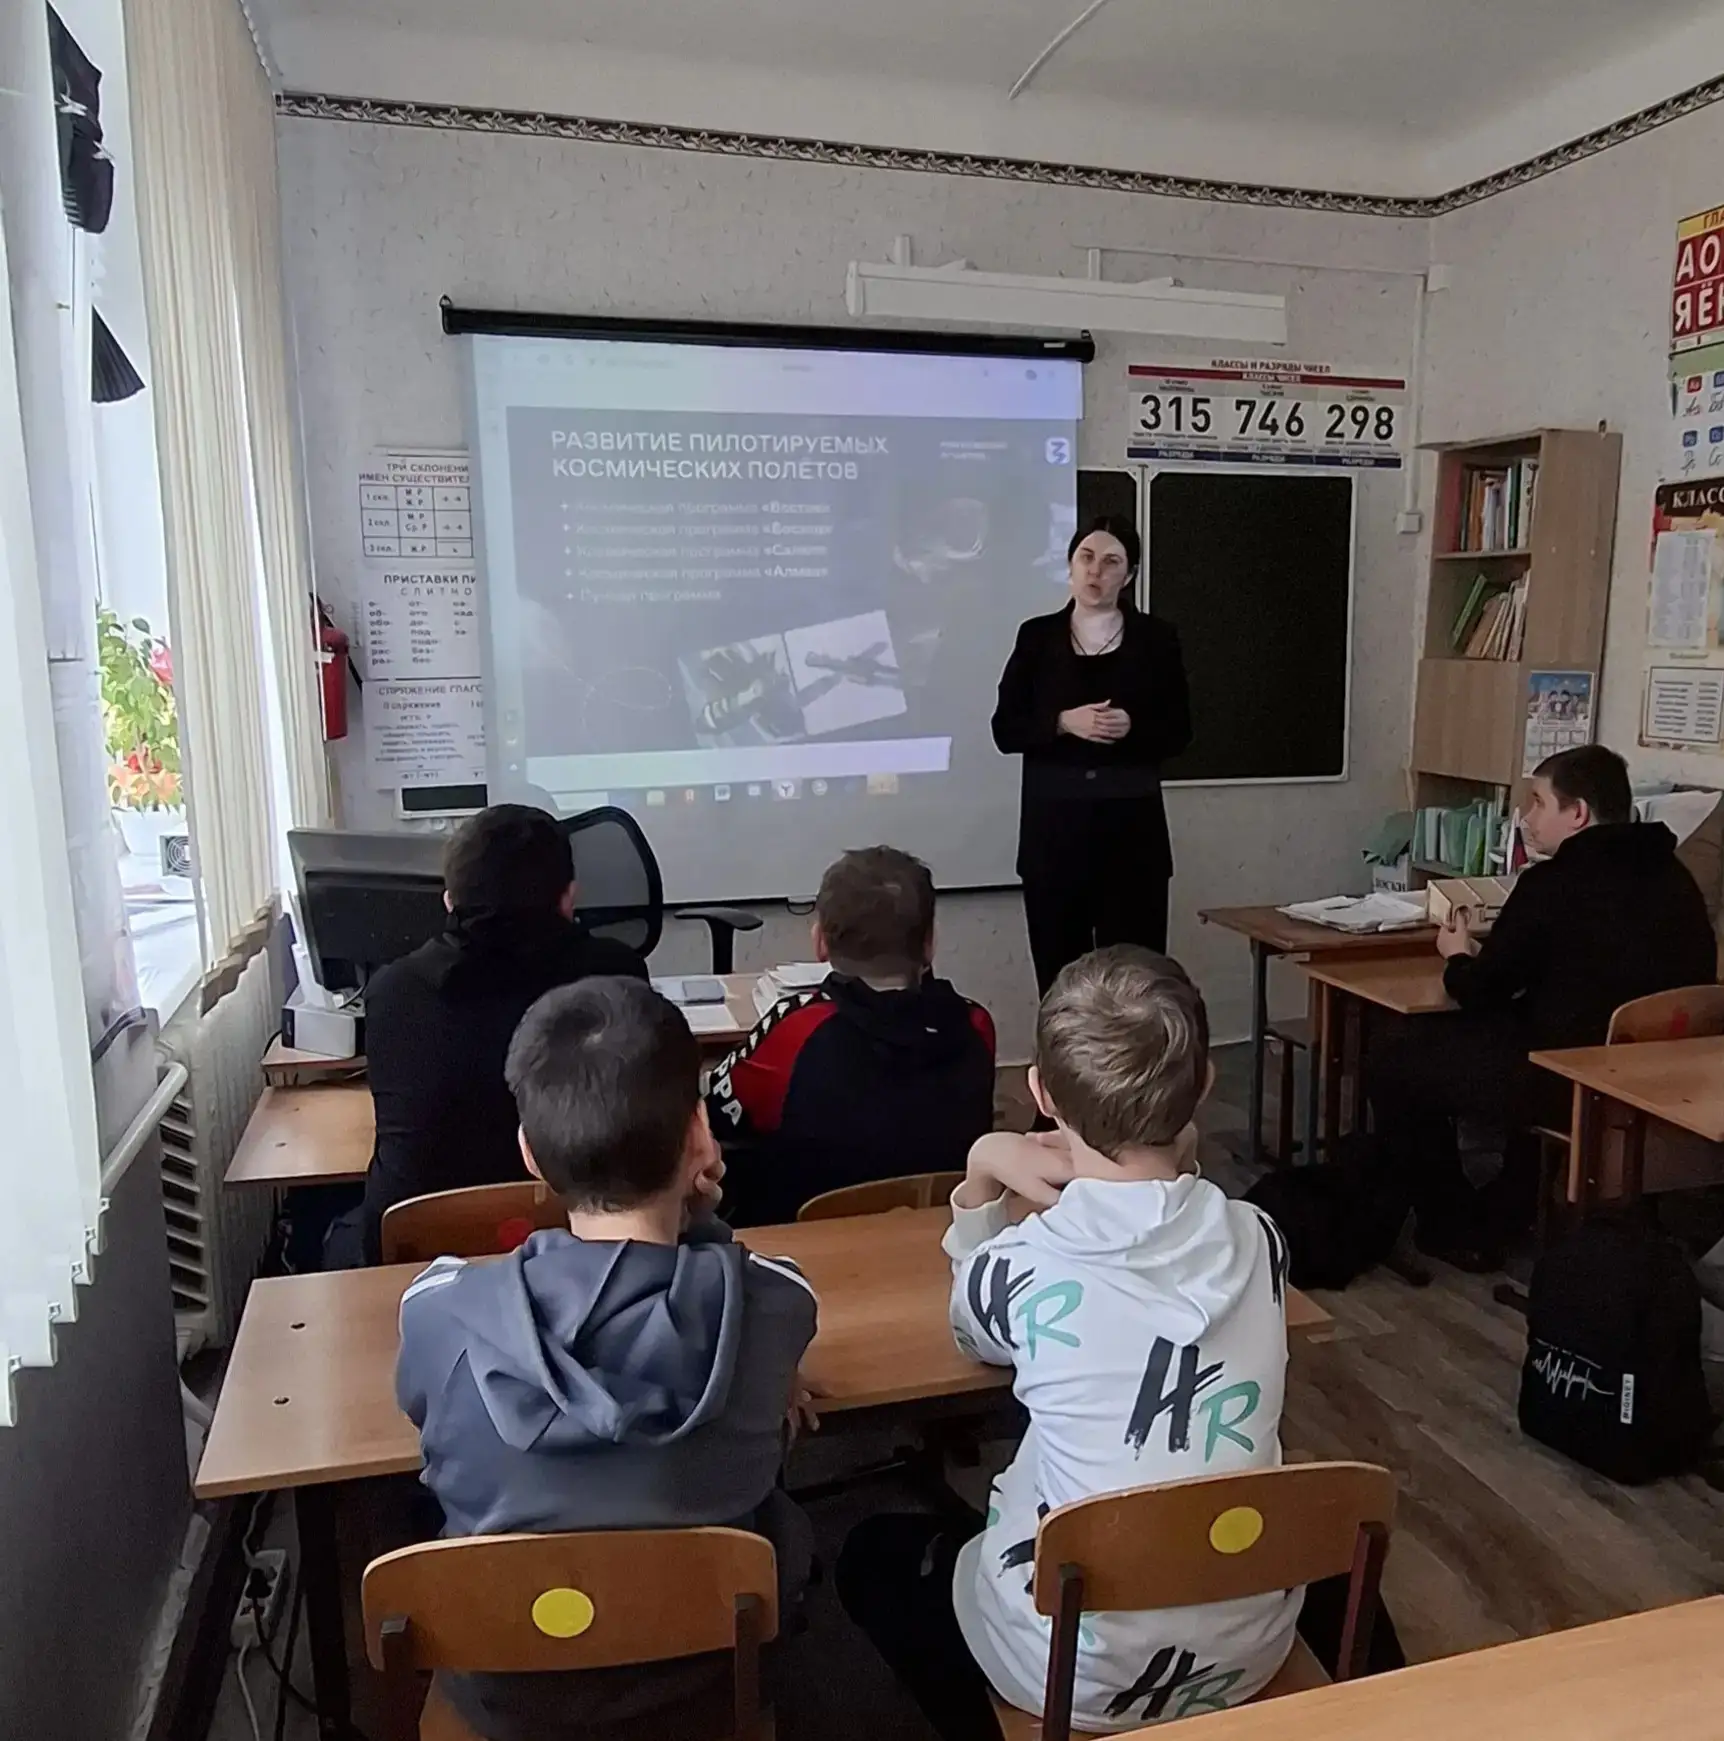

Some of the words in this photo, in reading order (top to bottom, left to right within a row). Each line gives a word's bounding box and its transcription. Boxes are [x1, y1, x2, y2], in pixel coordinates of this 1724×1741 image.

[1140, 394, 1211, 433] 315
[1235, 399, 1304, 436] 746
[1325, 404, 1394, 440] 298
[551, 430, 682, 451] РАЗВИТИЕ
[689, 433, 889, 454] ПИЛОТИРУЕМЫХ
[387, 463, 407, 471] ТРИ
[552, 457, 743, 480] КОСМИЧЕСКИХ
[384, 574, 459, 584] ПРИСТАВКИ
[378, 685, 446, 696] СПРЯЖЕНИЕ
[1123, 1335, 1262, 1464] HR
